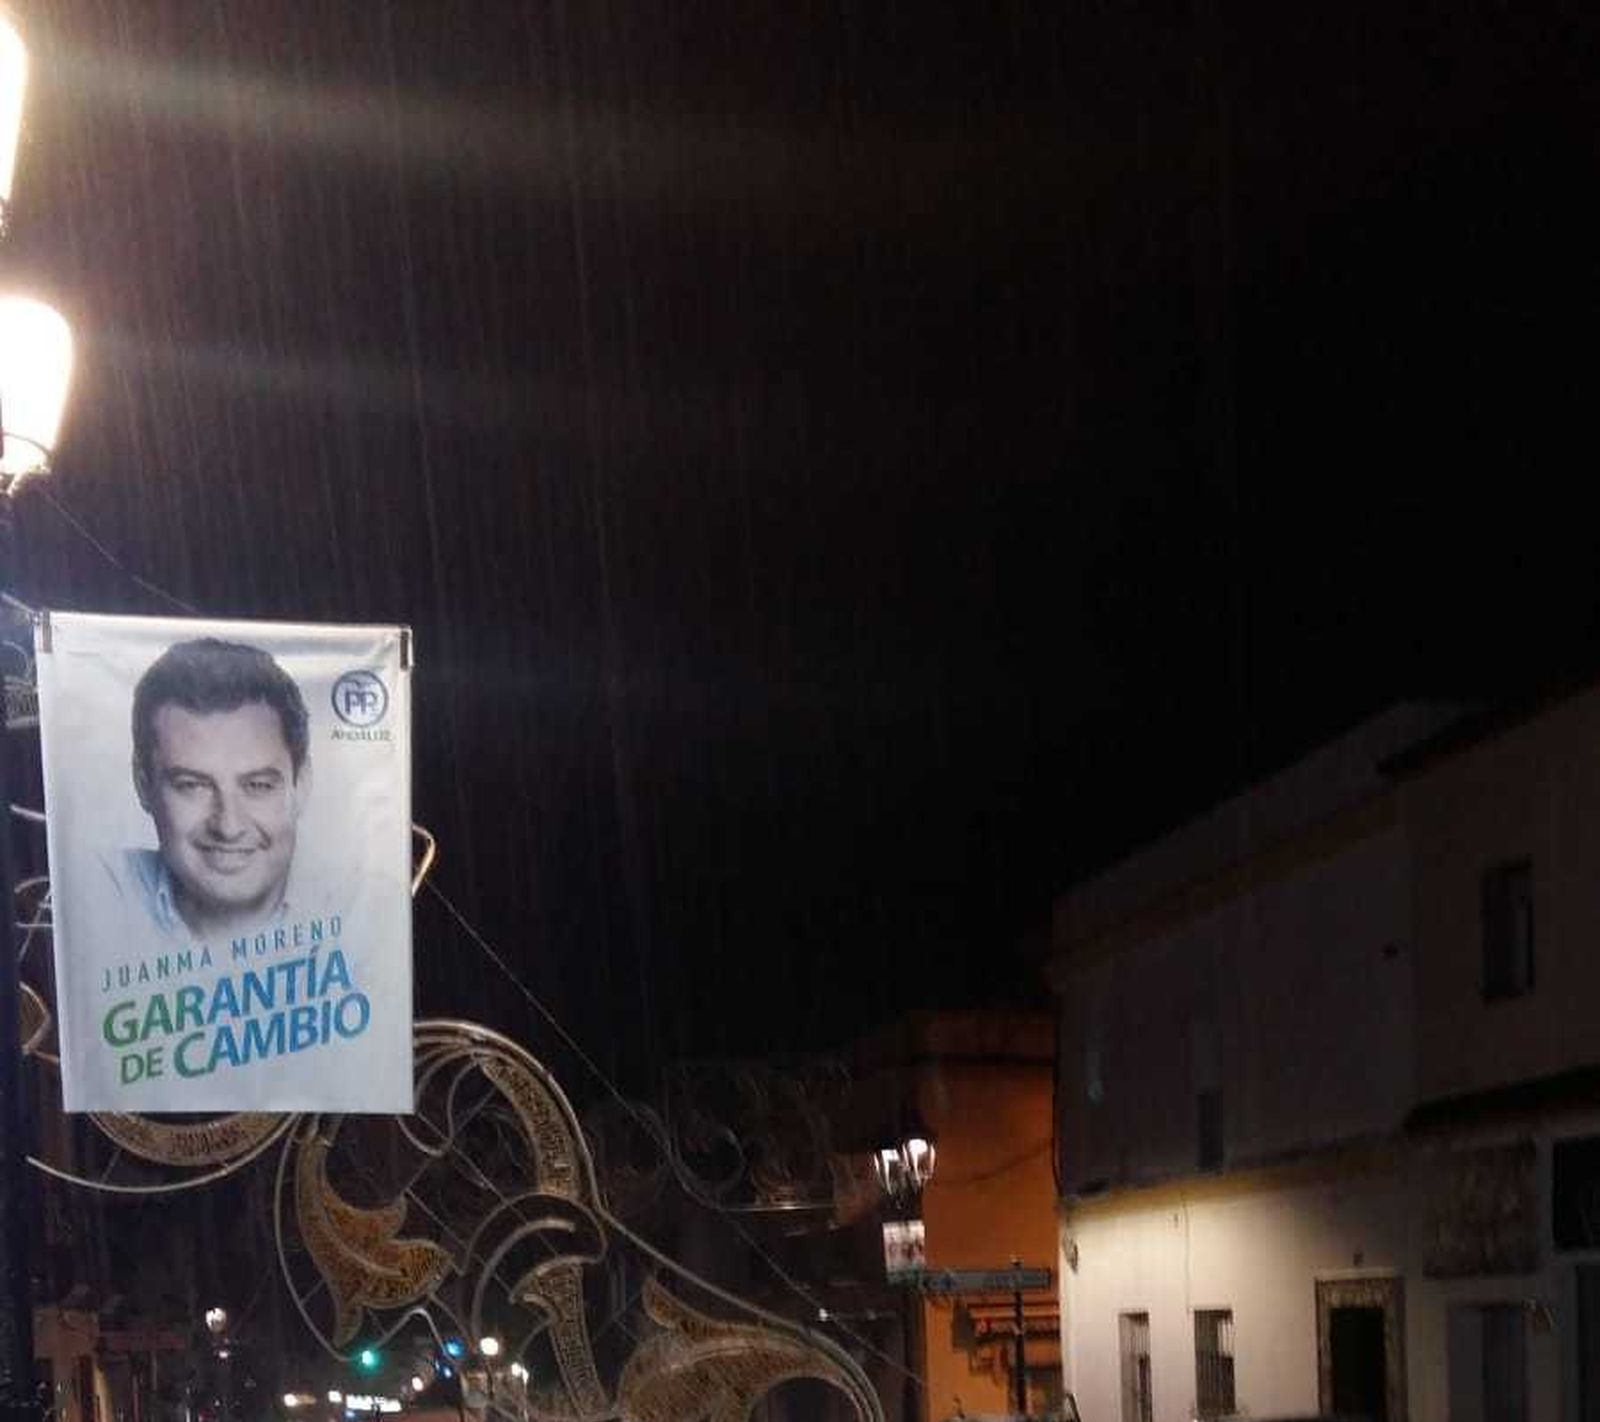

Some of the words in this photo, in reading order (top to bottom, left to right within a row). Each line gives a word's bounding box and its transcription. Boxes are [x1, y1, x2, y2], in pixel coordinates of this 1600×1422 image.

[101, 946, 213, 993] JUANMA
[231, 915, 342, 960] MORENO
[102, 945, 351, 1048] GARANTÍA
[120, 1046, 164, 1085] DE
[173, 992, 371, 1079] CAMBIO
